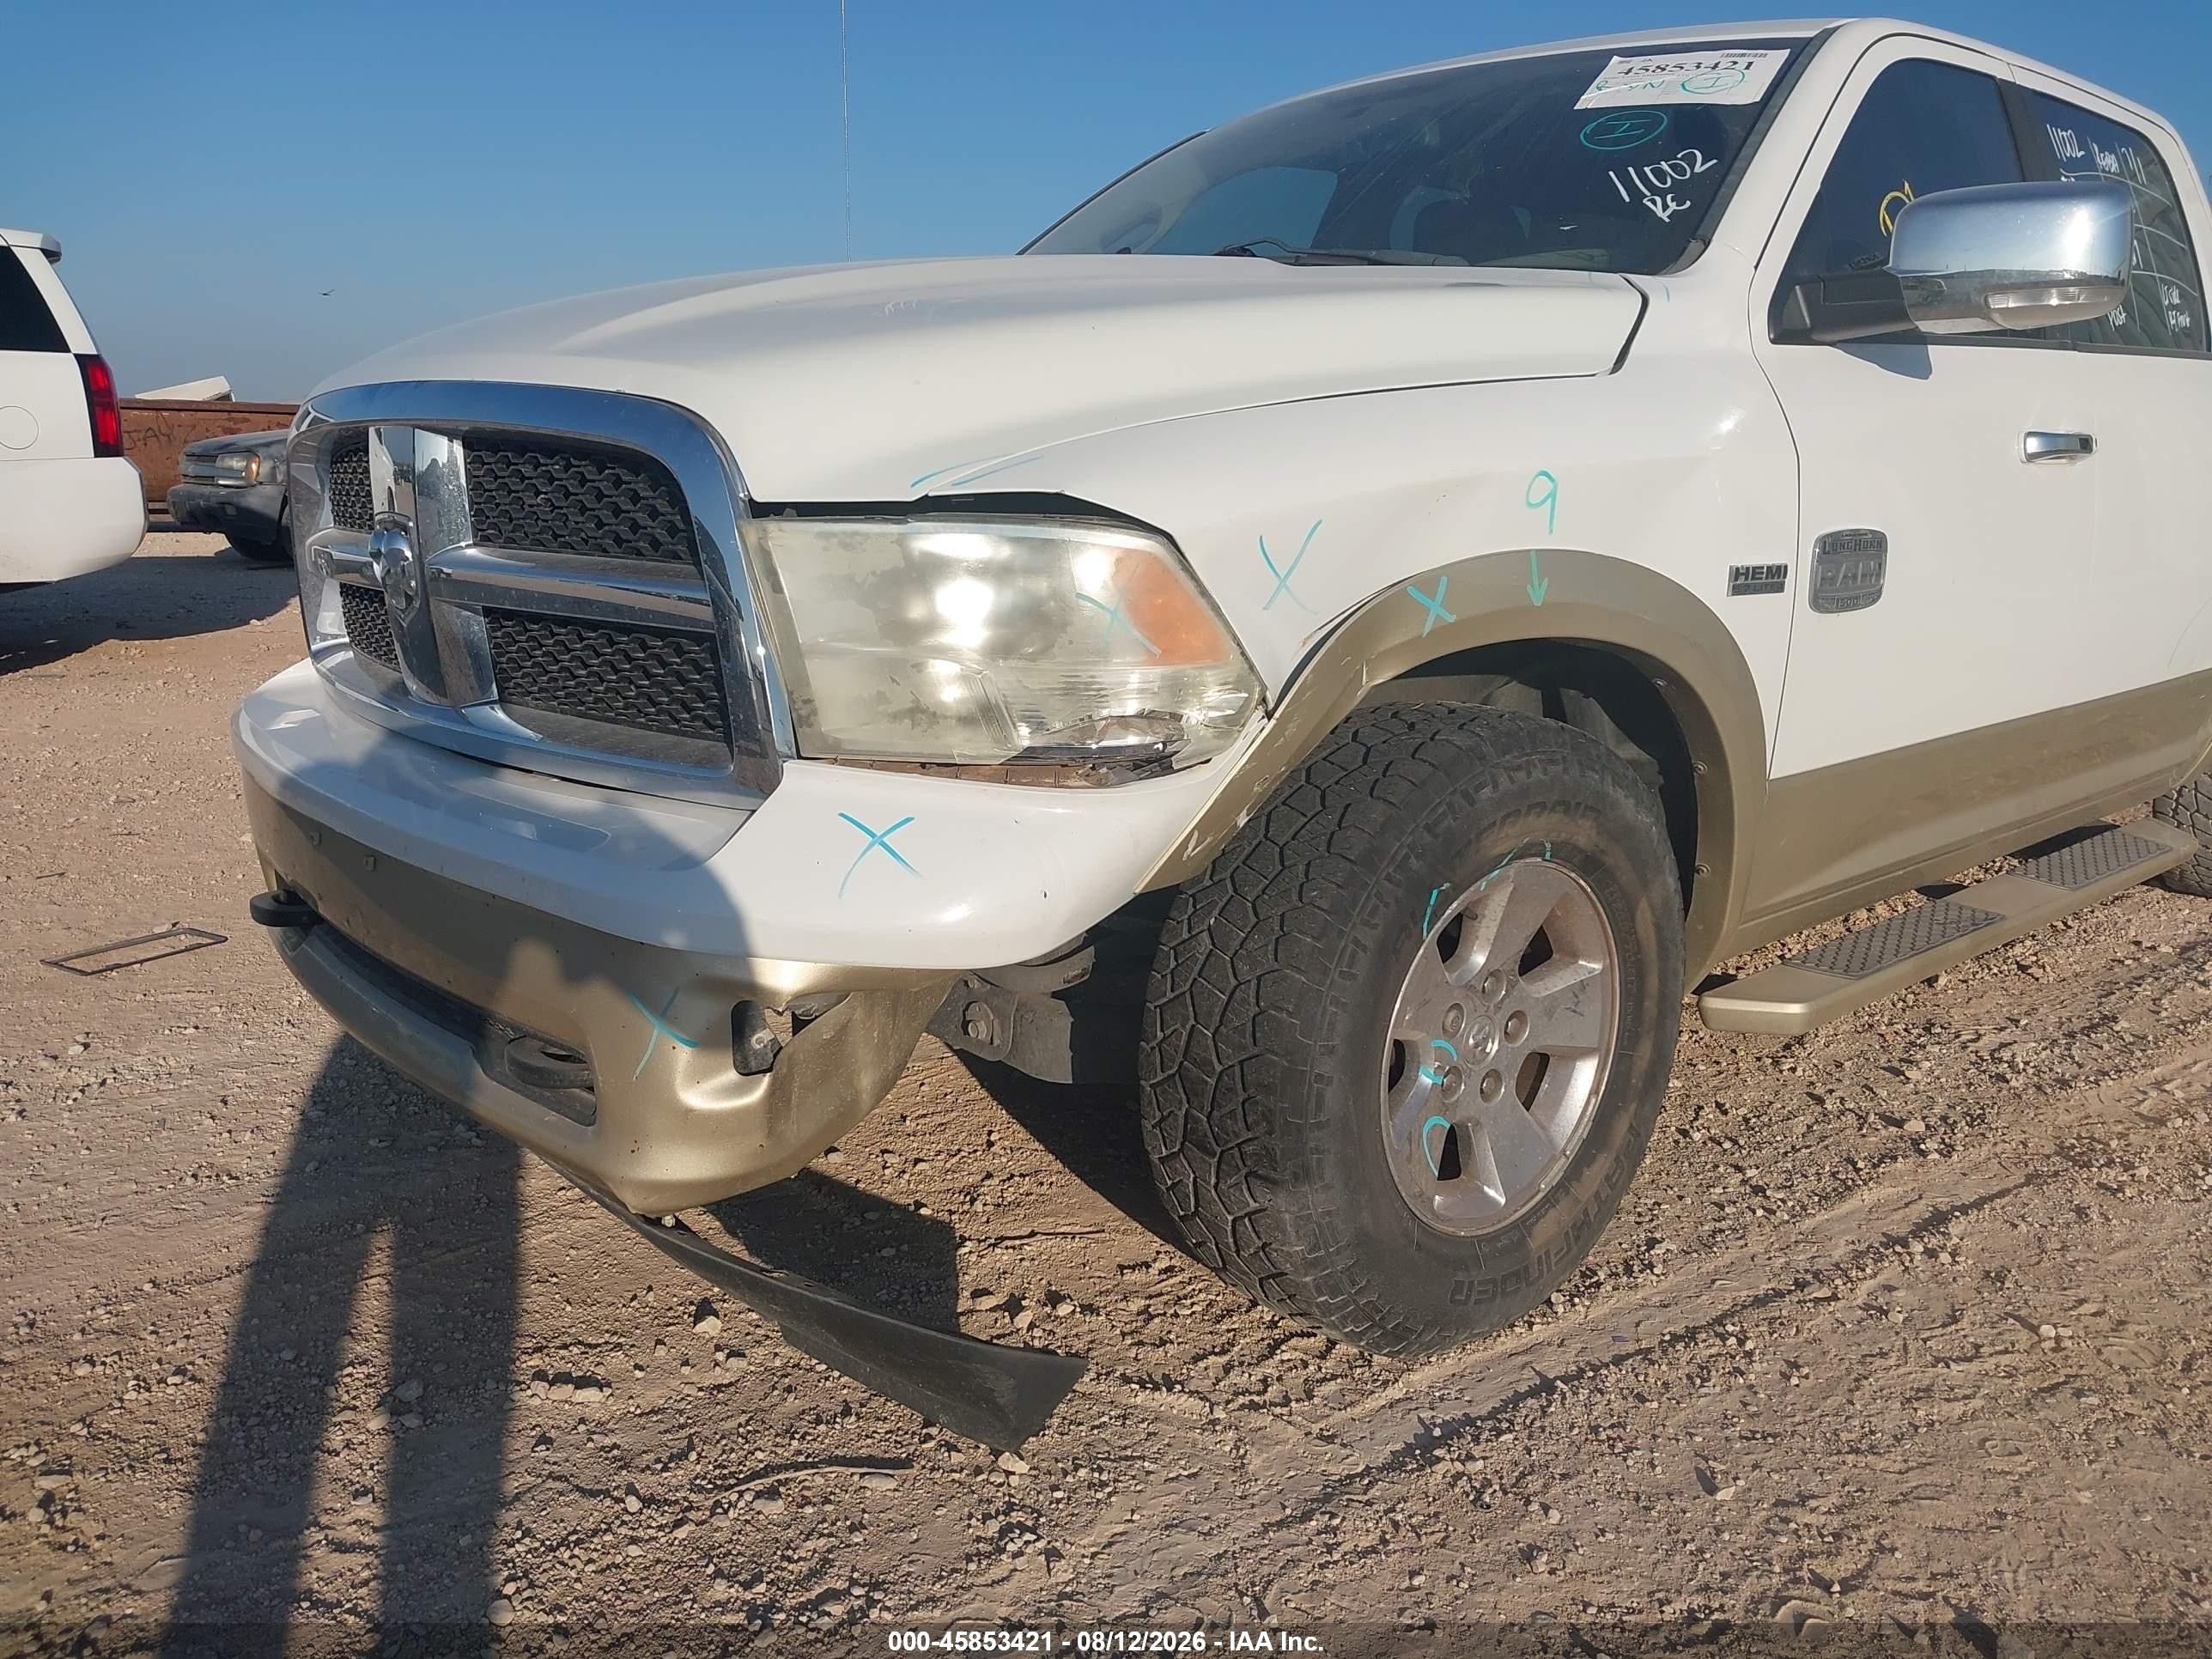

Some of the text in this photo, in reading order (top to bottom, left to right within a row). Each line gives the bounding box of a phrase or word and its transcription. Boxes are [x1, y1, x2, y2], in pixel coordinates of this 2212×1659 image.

[1618, 60, 1755, 76] 45853421
[1607, 149, 1718, 203] 11002
[1525, 469, 1559, 535] 9
[1733, 563, 1789, 583] HEMI
